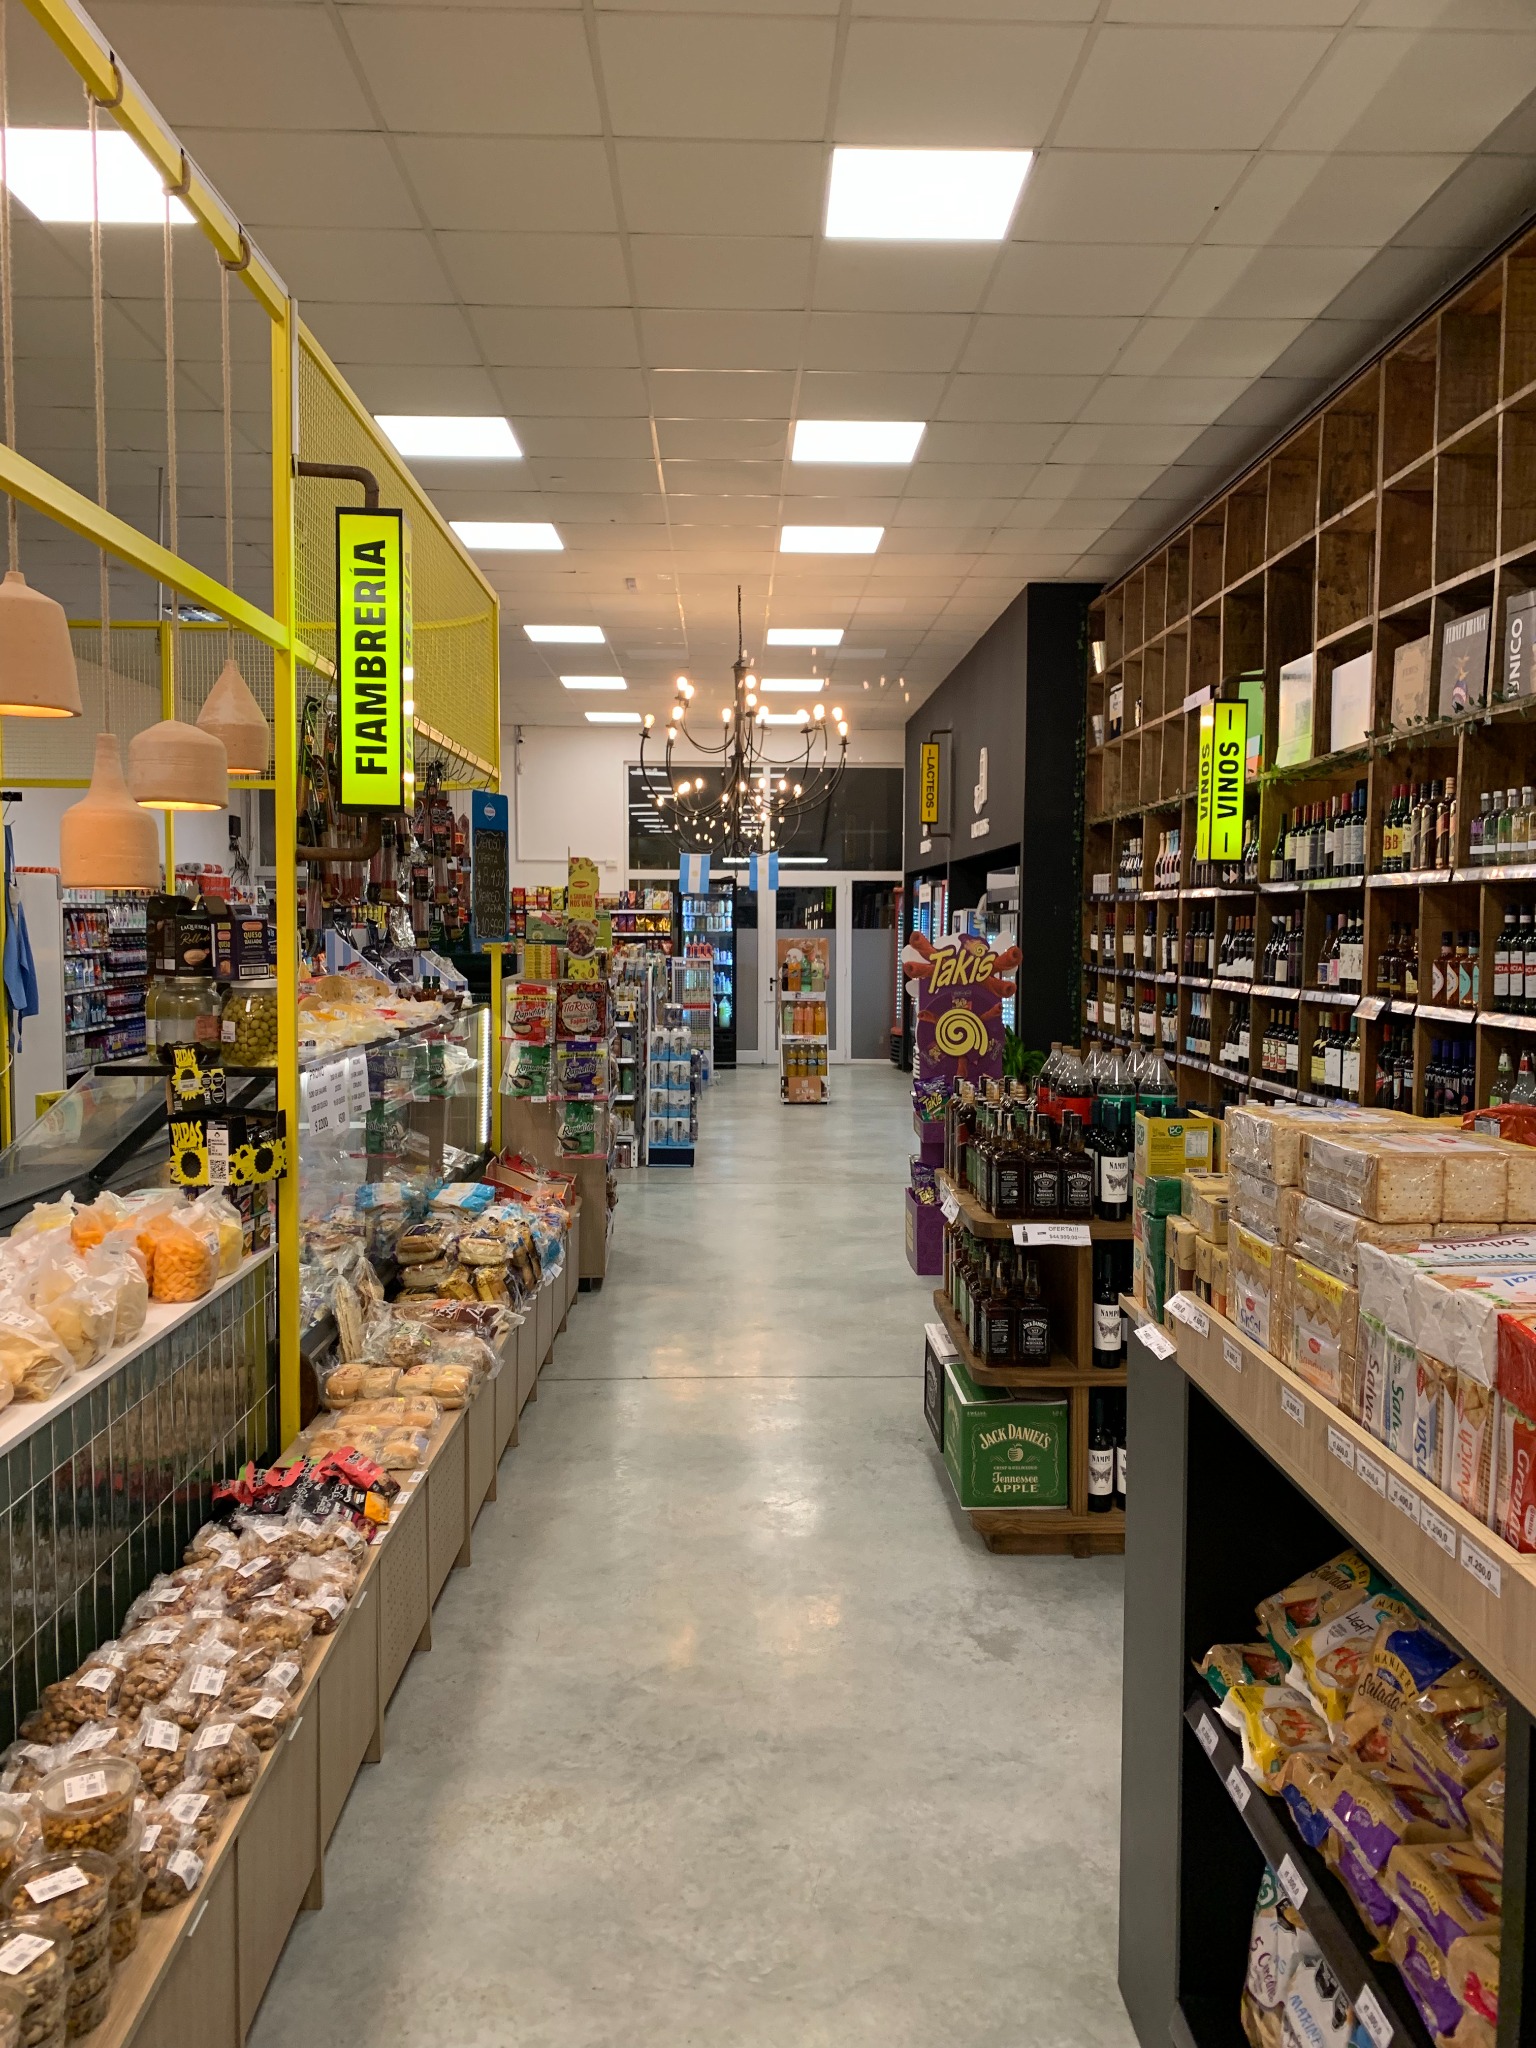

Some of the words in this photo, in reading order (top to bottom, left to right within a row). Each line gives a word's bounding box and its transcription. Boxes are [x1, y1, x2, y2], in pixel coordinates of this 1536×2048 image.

[349, 540, 388, 775] FIAMBRERÍA
[926, 757, 936, 809] LACTEOS
[1199, 743, 1211, 820] VINOS
[1217, 742, 1240, 819] VINOS
[928, 948, 997, 995] Takis
[174, 1048, 196, 1067] PIPAS
[923, 1092, 943, 1113] Takis
[171, 1120, 204, 1147] PIPAS
[1433, 1238, 1530, 1251] Salvado
[979, 1427, 1008, 1450] JACK
[1007, 1423, 1053, 1449] DANIEL'S
[992, 1472, 1039, 1484] Tennessee
[993, 1485, 1038, 1493] APPLE
[1345, 1611, 1374, 1635] LIGHT
[1374, 1654, 1417, 1698] MANIERI
